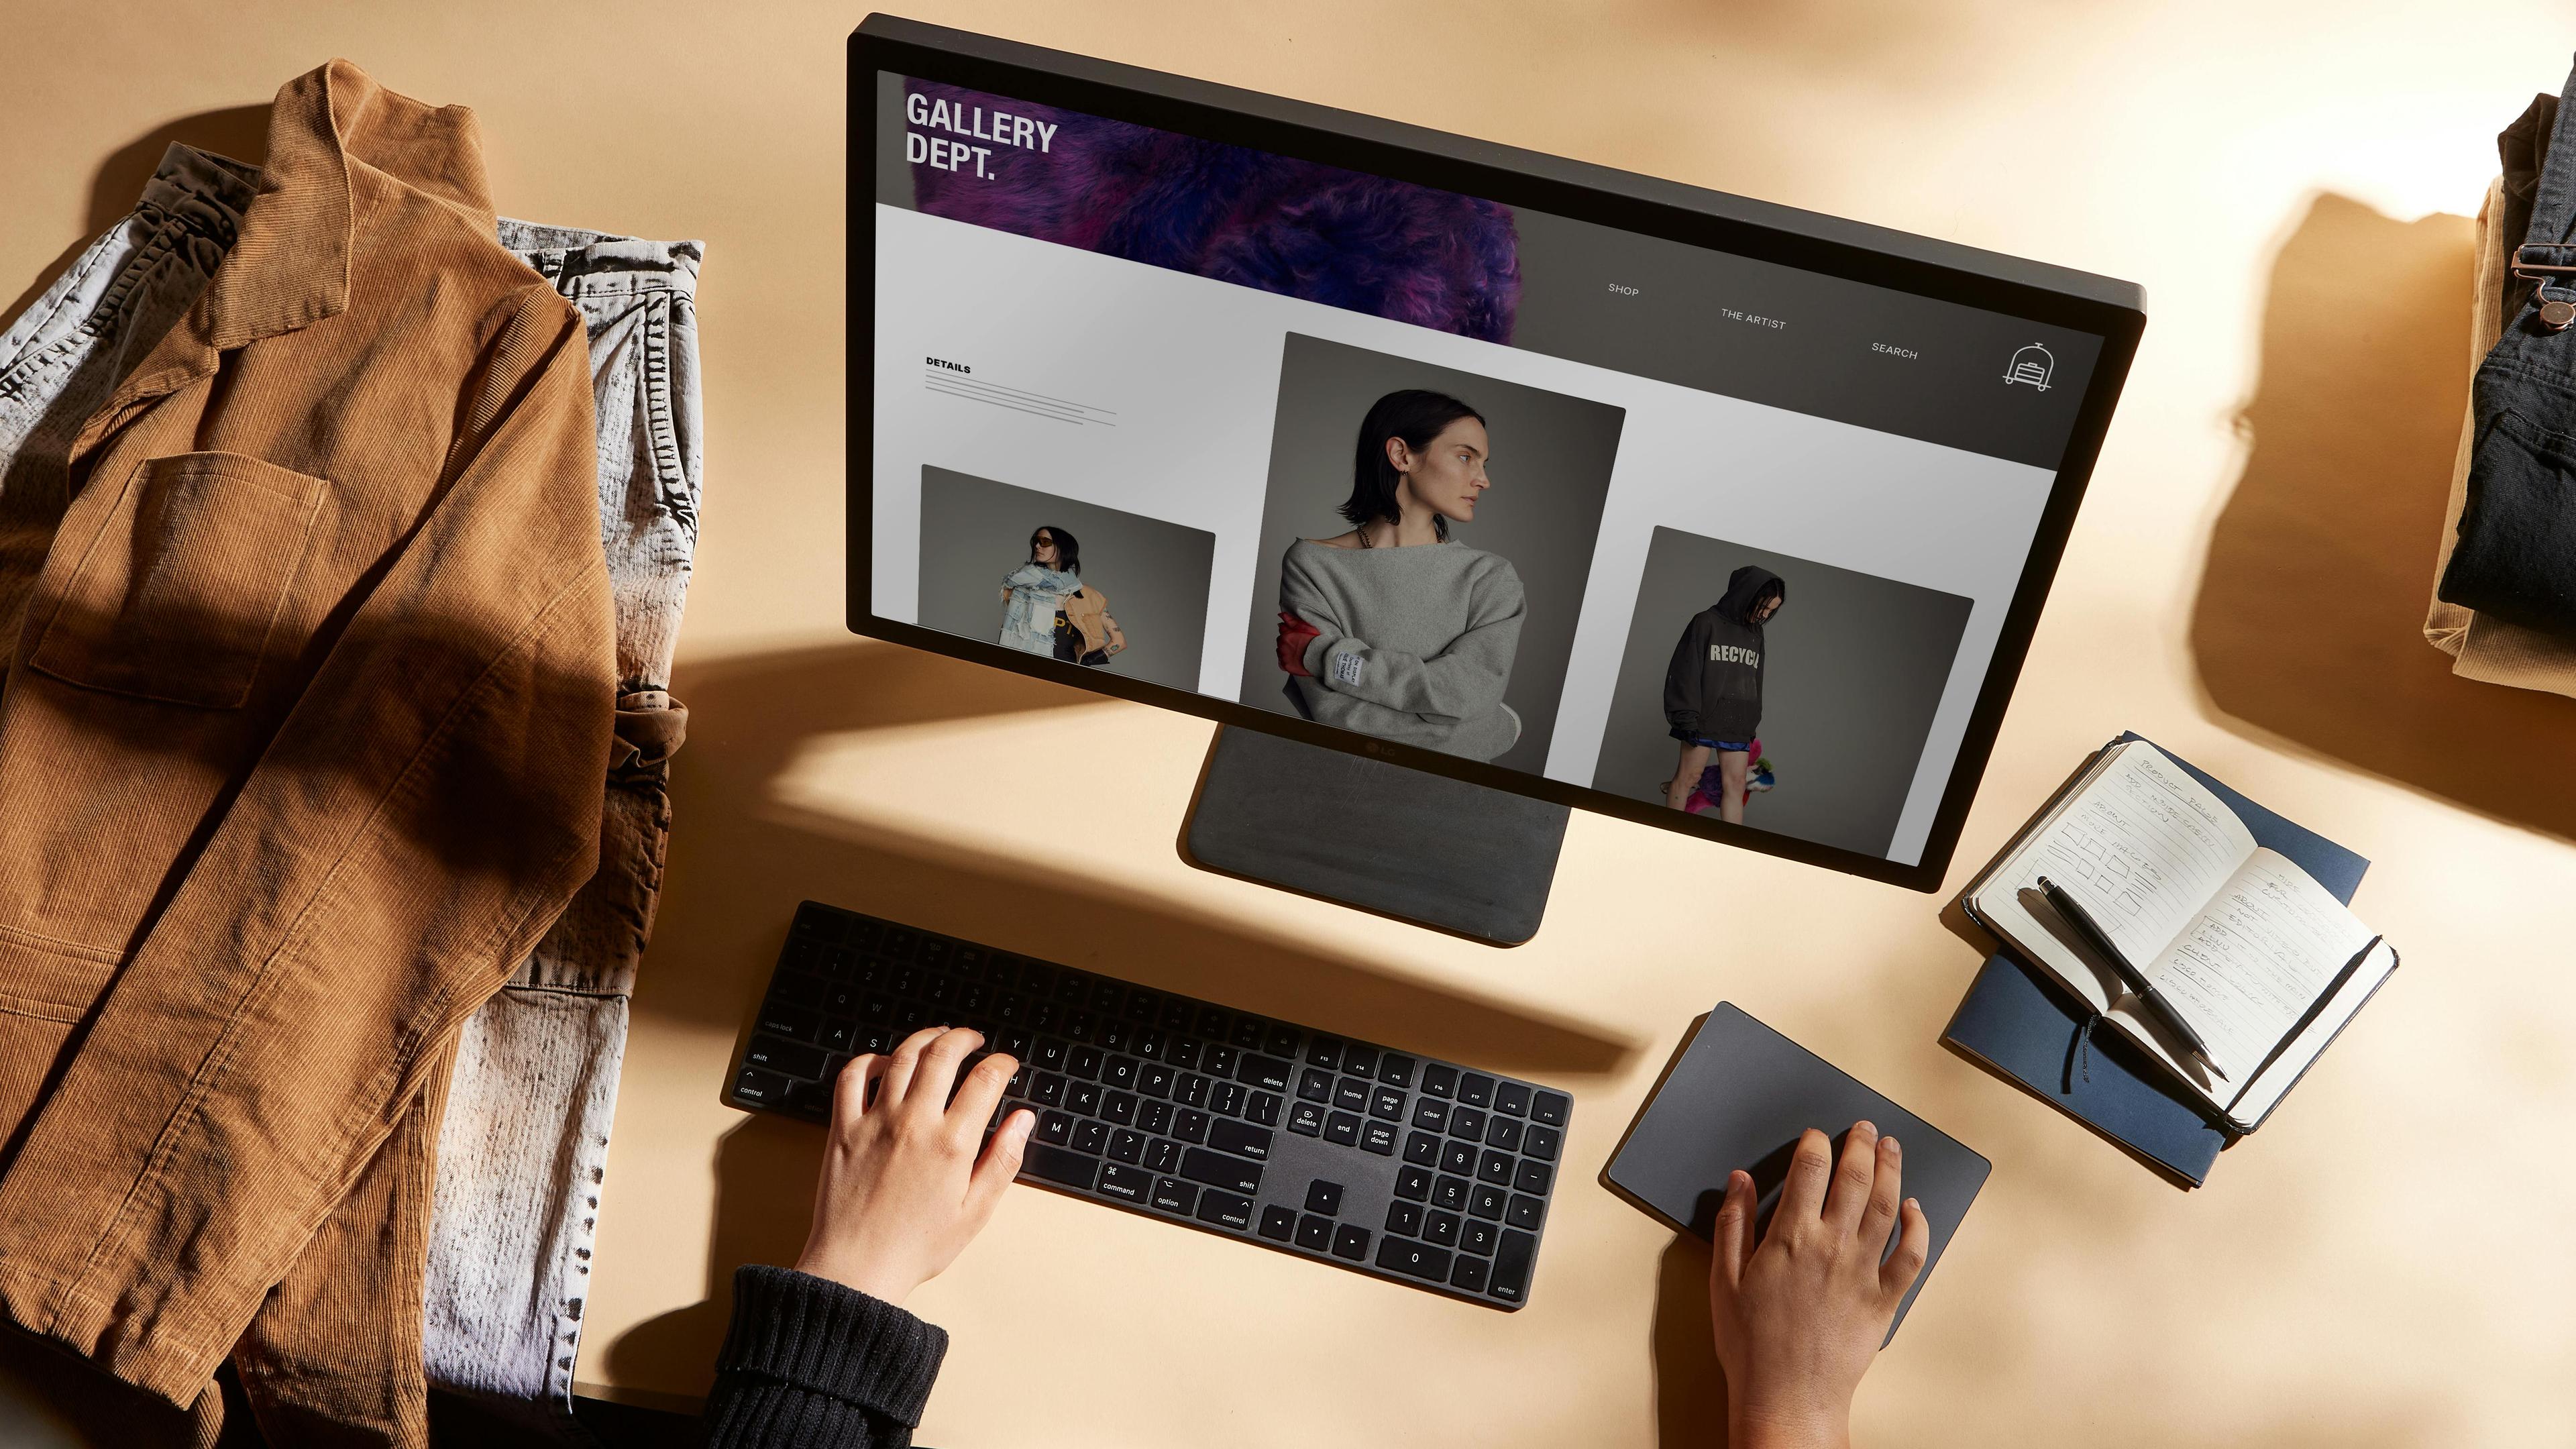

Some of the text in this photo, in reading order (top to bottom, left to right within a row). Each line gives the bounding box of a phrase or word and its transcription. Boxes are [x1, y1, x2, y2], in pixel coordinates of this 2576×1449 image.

[906, 93, 1058, 153] GALLERY
[906, 132, 995, 180] DEPT.
[1608, 283, 1640, 297] SHOP
[1721, 308, 1786, 330] THE ARTIST
[1872, 341, 1919, 360] SEARCH
[926, 357, 971, 374] DETAILS
[1381, 746, 1395, 757] LG
[2141, 759, 2184, 792] PRODUCT
[2094, 802, 2131, 826] ABOUT
[2081, 814, 2106, 835] MORE
[2234, 894, 2269, 916] ABOUT
[2210, 923, 2226, 936] ADD
[2237, 908, 2257, 922] NOT
[2265, 928, 2300, 957] VIDEO
[2184, 945, 2222, 968] CLIENT
[833, 963, 837, 971] 1
[865, 971, 873, 981] 2
[900, 980, 907, 989] 3
[934, 989, 942, 998] 4
[838, 994, 846, 1004] Q
[969, 998, 977, 1008] 5
[872, 1003, 883, 1012] W
[1004, 1008, 1011, 1016] 6
[908, 1012, 915, 1022] E
[1039, 1016, 1046, 1025] 7
[780, 1024, 792, 1032] lock
[1074, 1026, 1081, 1035] 8
[835, 1030, 841, 1038] A
[1109, 1035, 1116, 1043] 9
[869, 1038, 877, 1048] S
[1014, 1039, 1020, 1049] Y
[1047, 1049, 1056, 1058] U
[1144, 1044, 1152, 1053] 0
[753, 1053, 767, 1062] shift
[1084, 1058, 1089, 1067] I
[1118, 1067, 1126, 1076] O
[1010, 1075, 1018, 1085] H
[1153, 1075, 1161, 1085] P
[1193, 1079, 1198, 1089] {
[1263, 1077, 1283, 1087] delete
[740, 1087, 763, 1097] control
[1046, 1085, 1053, 1093] J
[1228, 1087, 1234, 1097] }
[1344, 1089, 1362, 1099] home
[1081, 1093, 1089, 1104] K
[1189, 1091, 1194, 1101] [
[1382, 1095, 1398, 1104] page
[1117, 1103, 1123, 1112] L
[1224, 1100, 1230, 1110] ]
[1424, 1110, 1440, 1119] clear
[1152, 1118, 1157, 1126] ;
[1296, 1116, 1317, 1127] delete
[1051, 1122, 1061, 1133] M
[1373, 1128, 1390, 1138] page
[1502, 1128, 1508, 1138] /
[1126, 1135, 1133, 1143] >
[1371, 1136, 1389, 1146] down
[1163, 1144, 1170, 1154] ?
[1244, 1145, 1265, 1155] return
[1420, 1143, 1428, 1152] 7
[1159, 1156, 1166, 1166] /
[1456, 1153, 1464, 1163] 8
[1493, 1163, 1501, 1172] 9
[1239, 1181, 1254, 1190] shift
[1411, 1179, 1418, 1188] 4
[1103, 1183, 1135, 1195] command
[1448, 1187, 1455, 1197] 5
[1158, 1197, 1179, 1208] option
[1485, 1197, 1492, 1207] 6
[1222, 1214, 1246, 1224] control
[1404, 1214, 1408, 1223] 1
[1439, 1223, 1446, 1233] 2
[1476, 1232, 1483, 1242] 3
[1411, 1253, 1419, 1263] 0
[1497, 1286, 1515, 1295] enter
